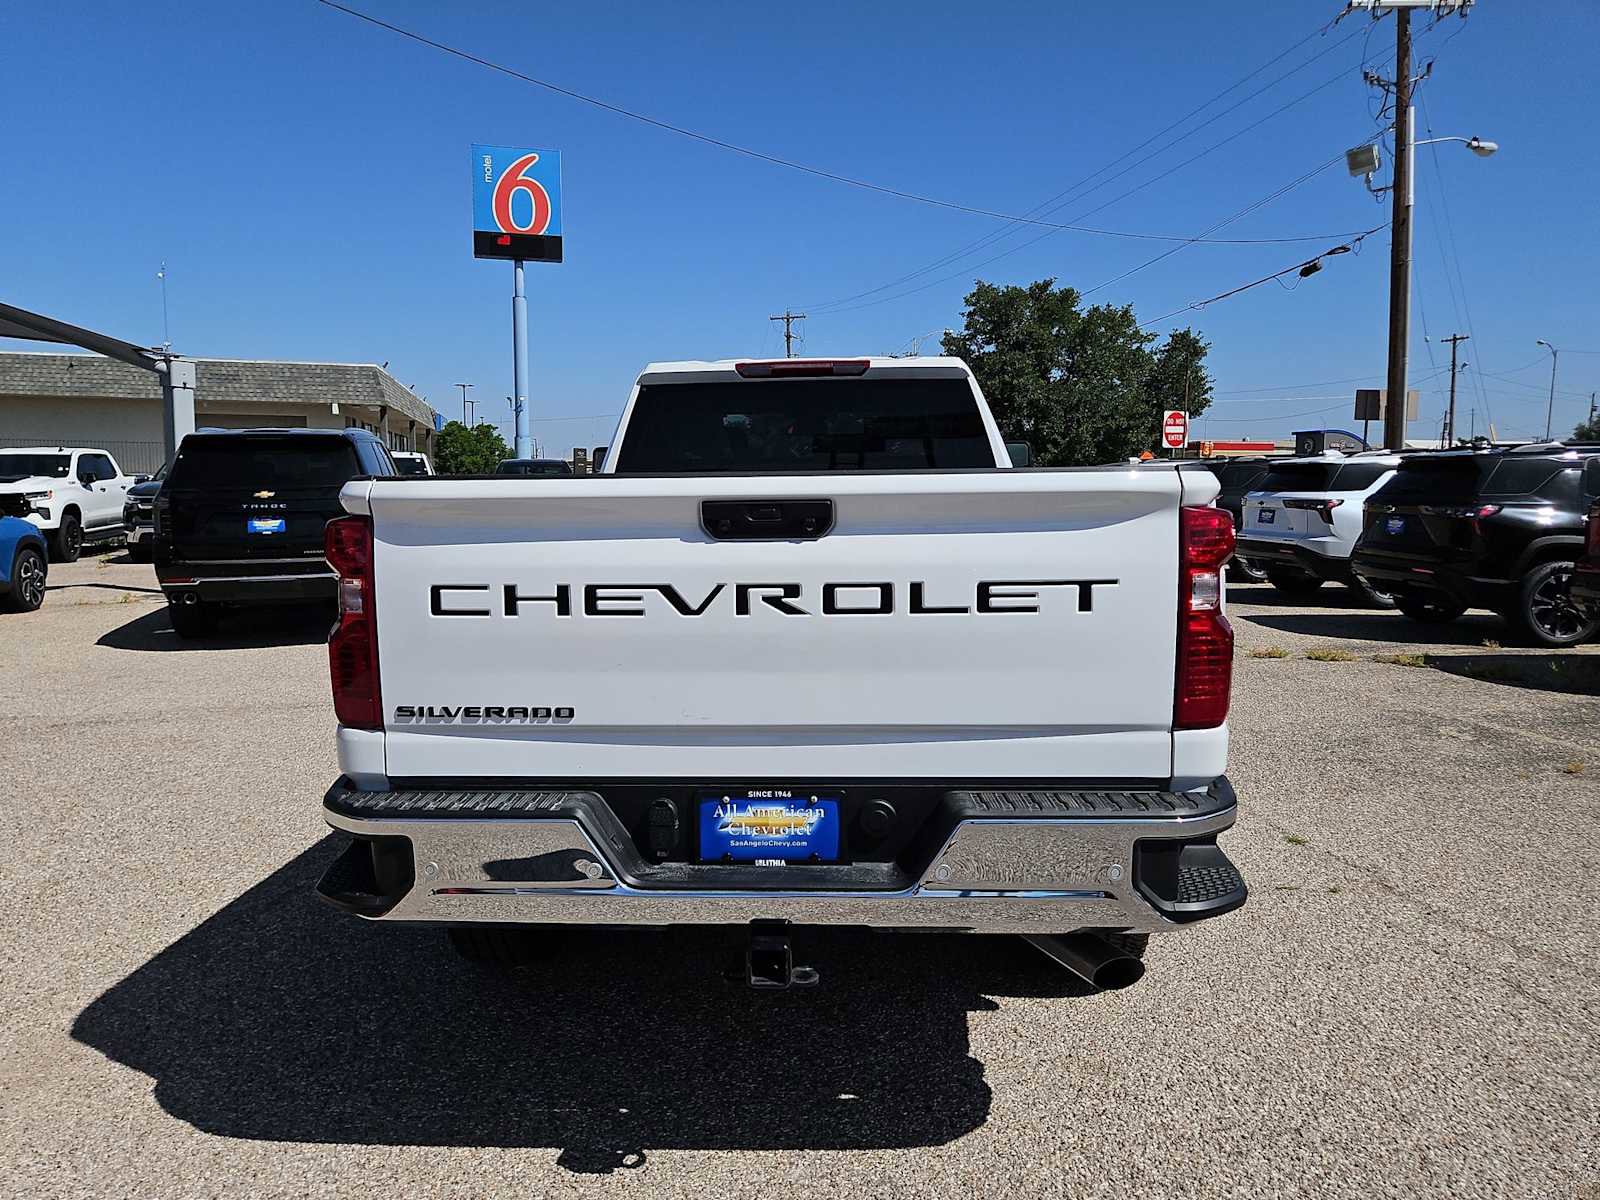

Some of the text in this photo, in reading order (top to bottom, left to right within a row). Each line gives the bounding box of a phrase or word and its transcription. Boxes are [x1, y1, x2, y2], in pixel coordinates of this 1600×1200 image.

[482, 155, 492, 182] motel
[492, 153, 551, 235] 6
[429, 579, 1120, 617] CHEVROLET
[395, 705, 576, 721] SILVERADO
[747, 790, 792, 798] SINCE 1946
[713, 804, 825, 819] All American
[728, 821, 812, 836] Chevrolet
[730, 839, 808, 848] SanAngeloChevy.com
[761, 859, 787, 867] LITHIA
